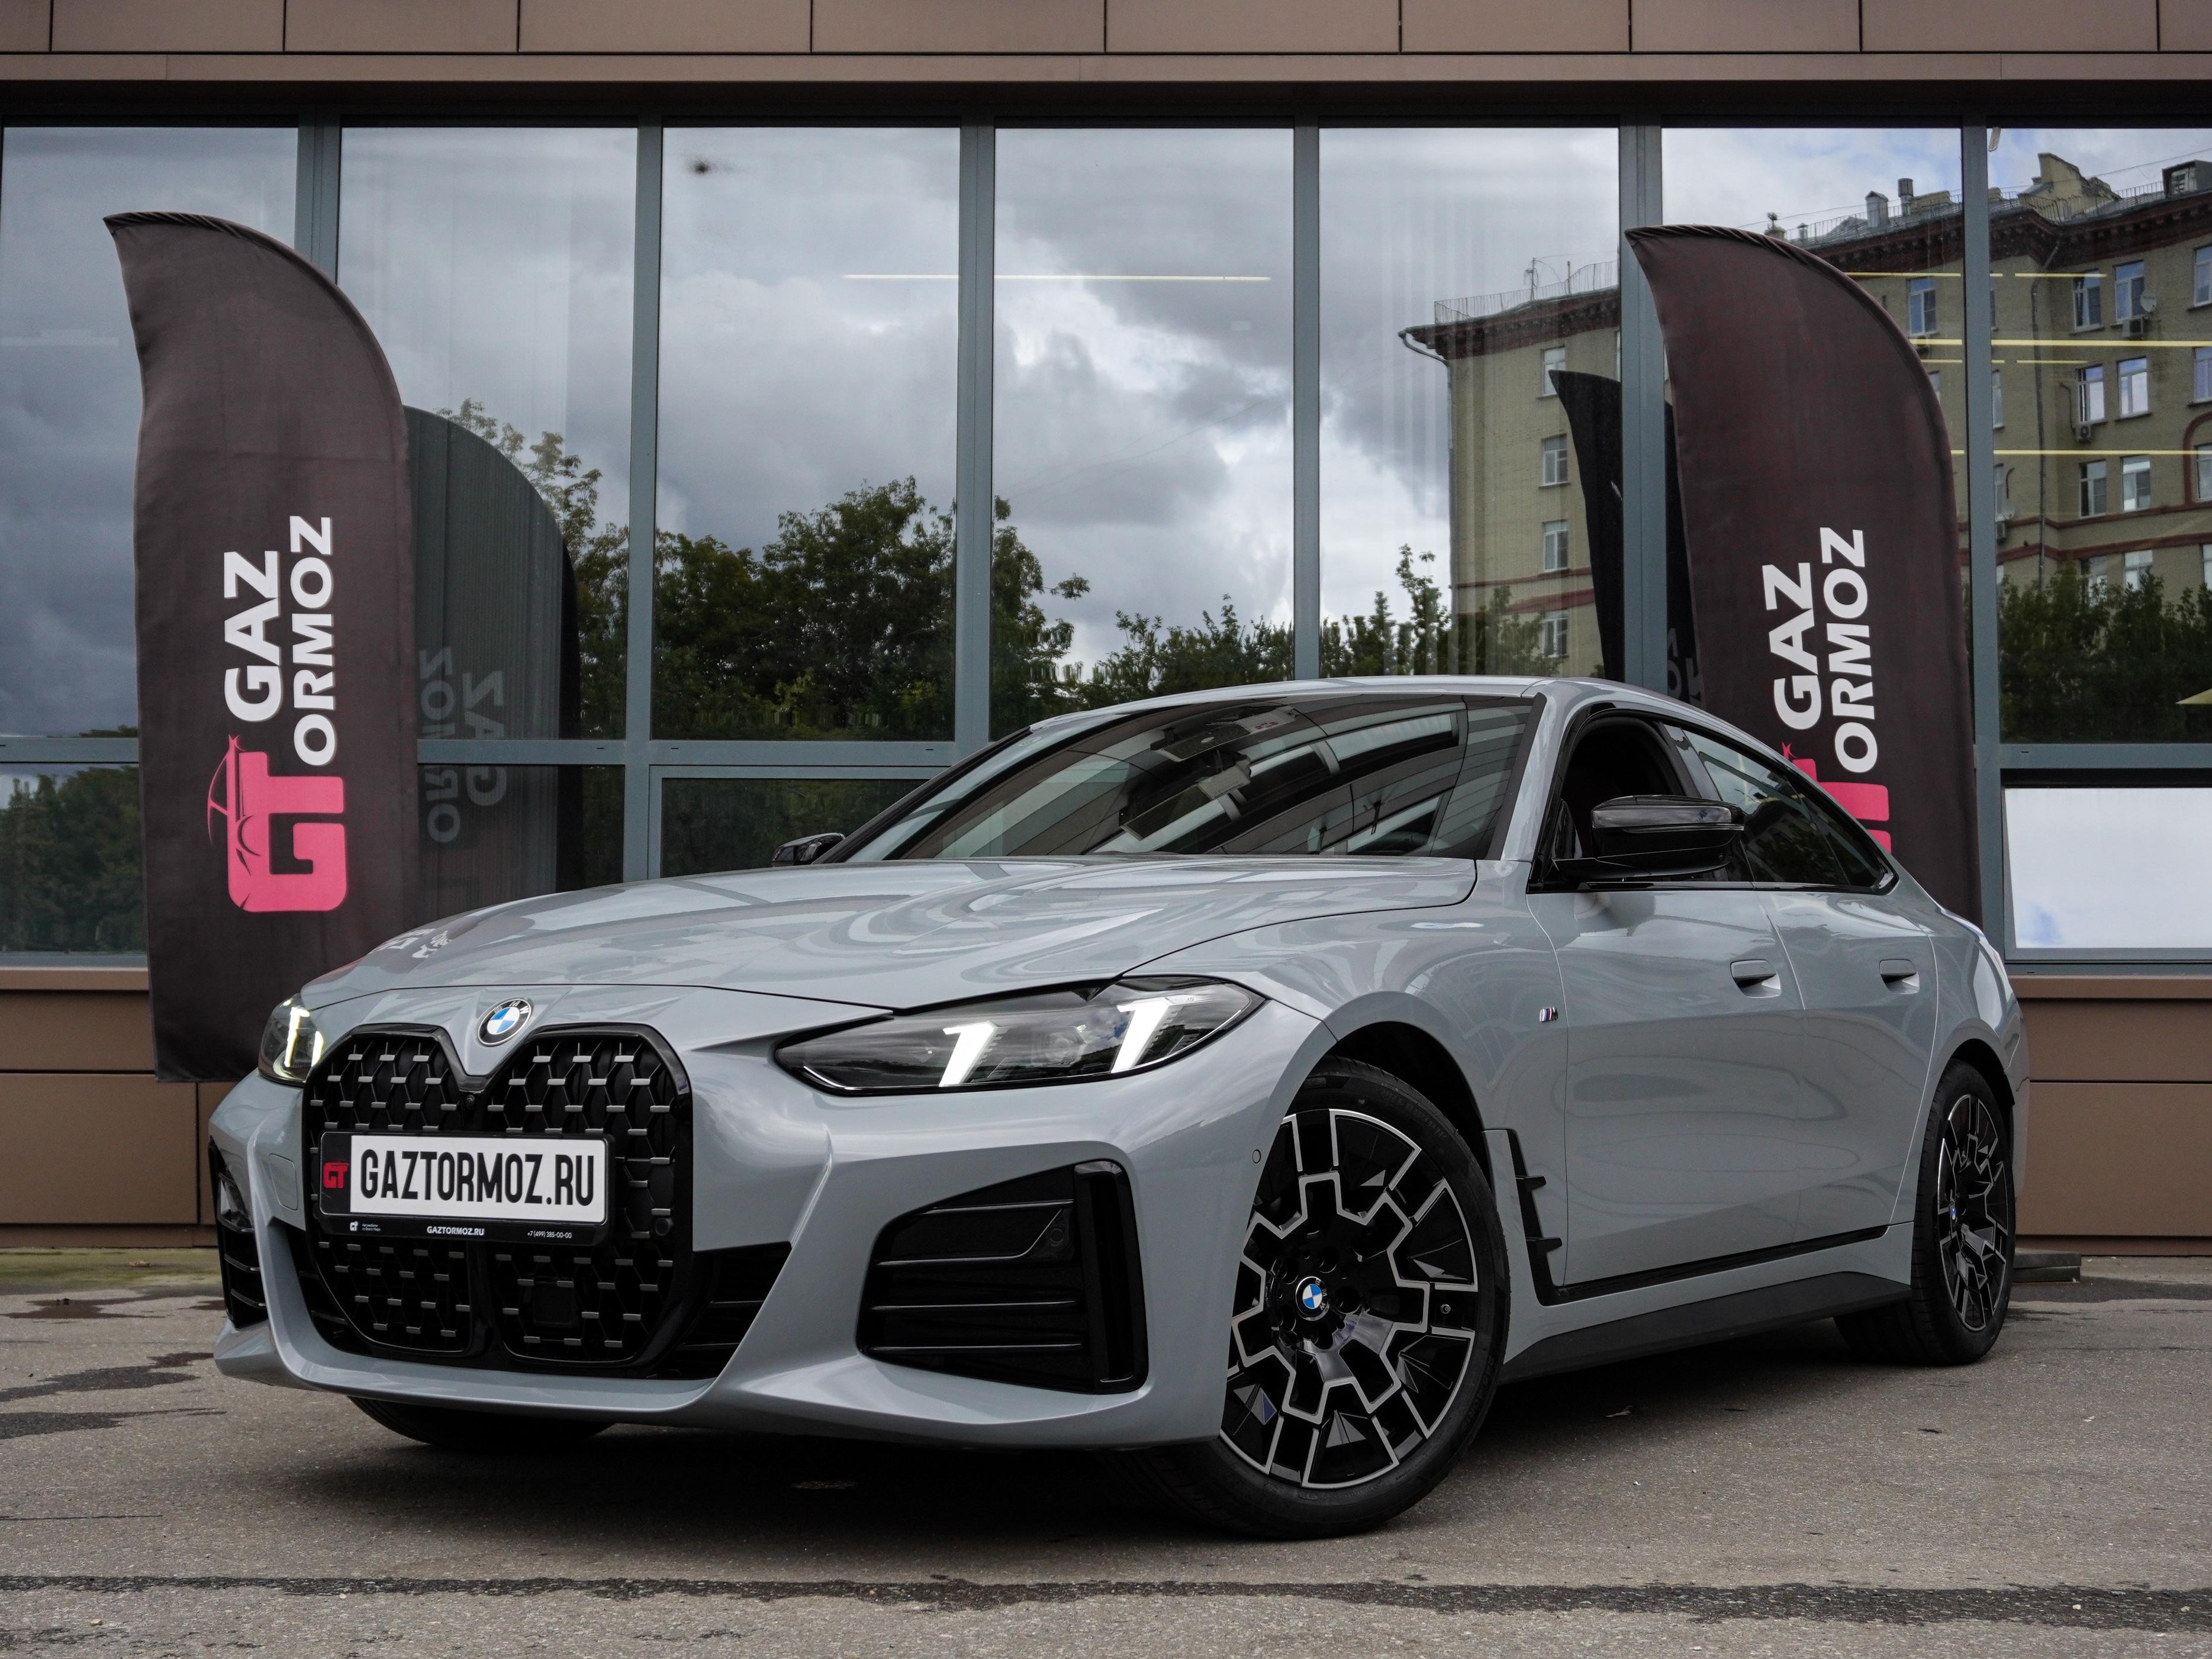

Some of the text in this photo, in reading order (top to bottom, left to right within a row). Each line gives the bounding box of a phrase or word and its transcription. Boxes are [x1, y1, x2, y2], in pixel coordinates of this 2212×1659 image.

[224, 550, 281, 721] GAZ
[289, 516, 336, 765] ORMOZ
[1762, 562, 1822, 730] GAZ
[1820, 527, 1878, 772] ORMOZ
[226, 747, 347, 913] GT
[323, 1162, 349, 1188] GT
[360, 1149, 594, 1206] GAZTORMOZ.RU
[427, 1226, 484, 1236] GAZTORMOZ.RU
